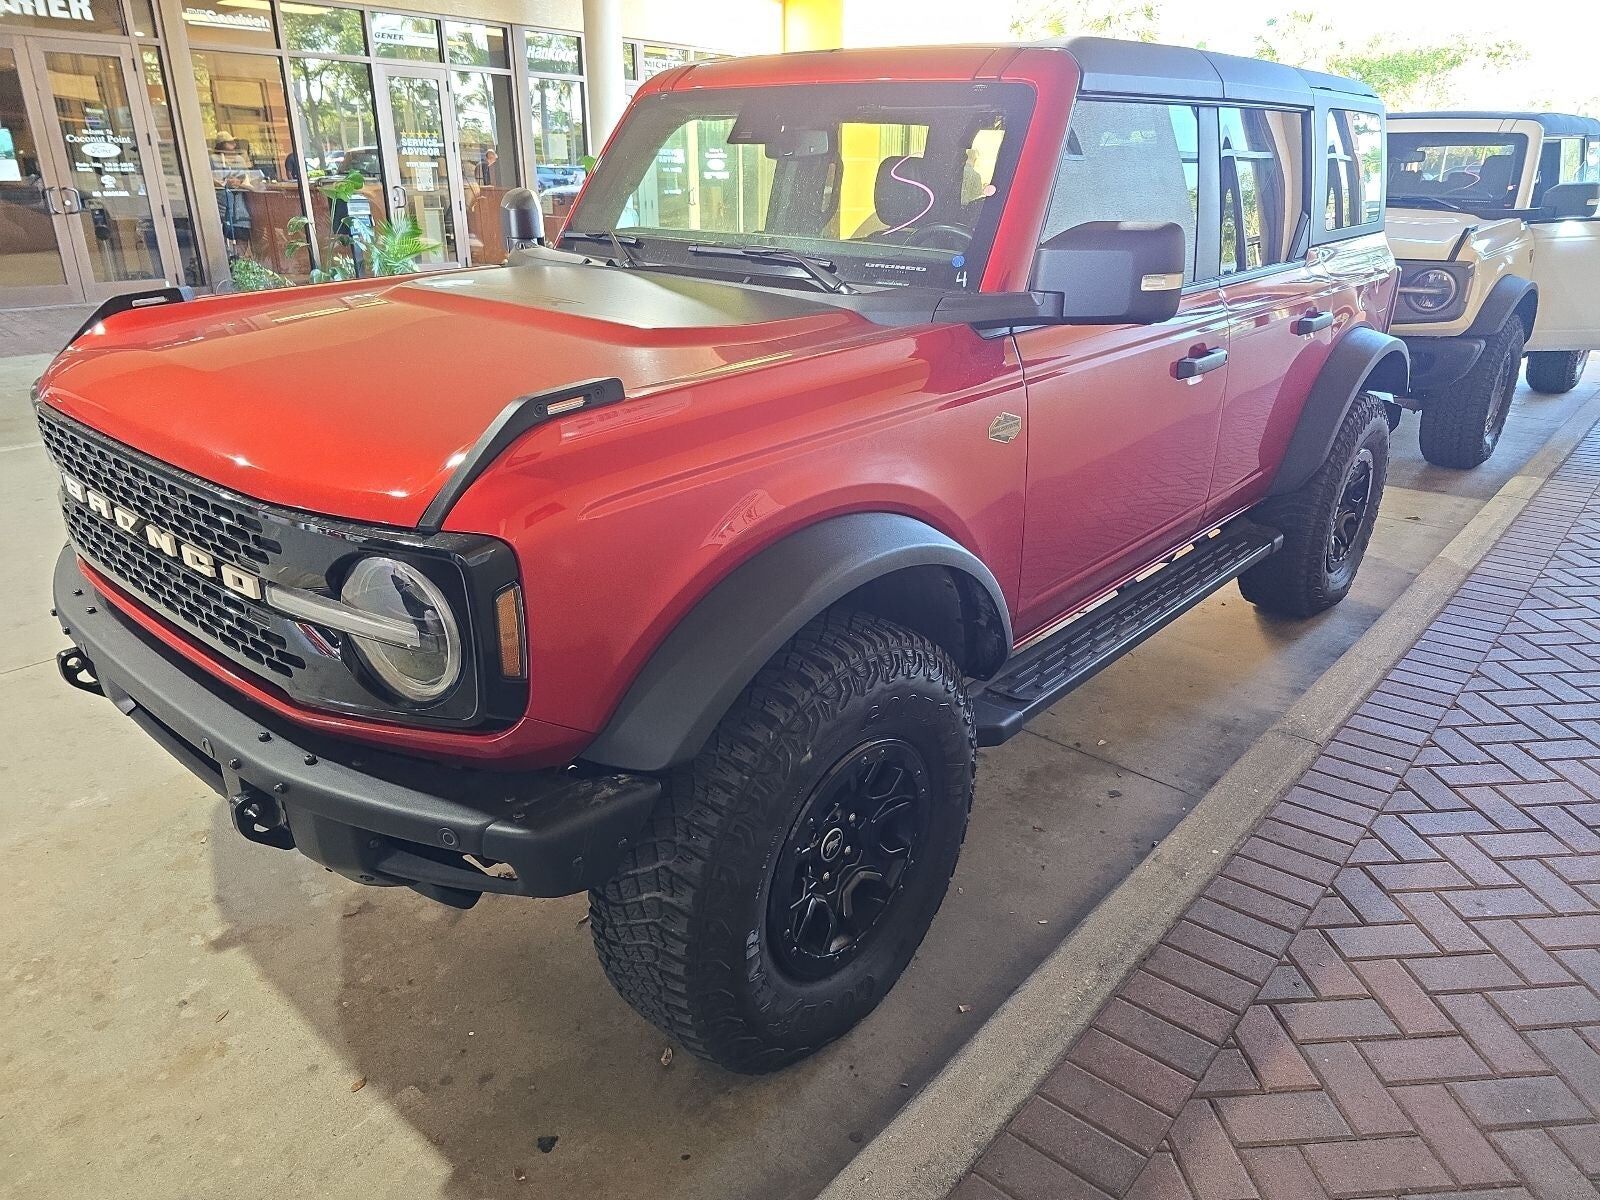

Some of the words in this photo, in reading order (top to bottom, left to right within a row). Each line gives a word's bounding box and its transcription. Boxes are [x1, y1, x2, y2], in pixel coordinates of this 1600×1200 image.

[65, 133, 106, 143] Coconut
[106, 134, 132, 144] Point
[401, 138, 438, 147] SERVICE
[401, 147, 440, 156] ADVISOR
[955, 270, 968, 288] 4
[62, 472, 262, 600] BRONCO
